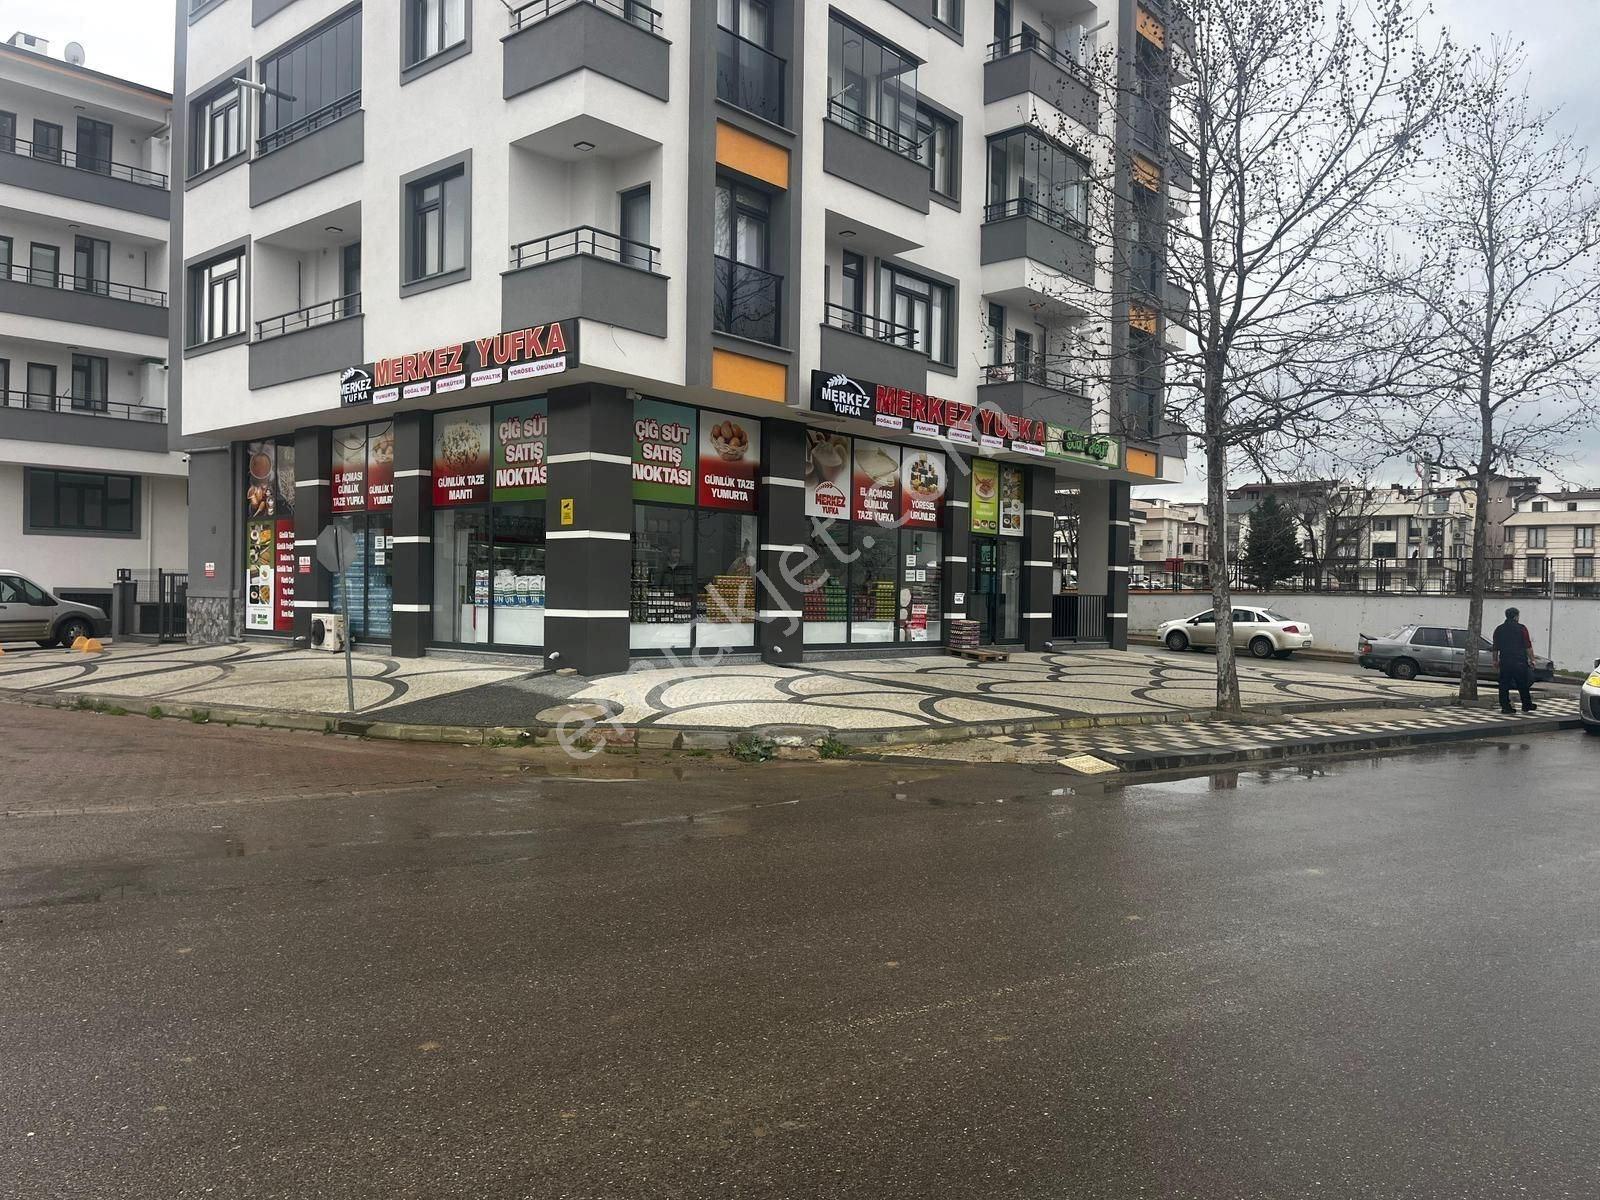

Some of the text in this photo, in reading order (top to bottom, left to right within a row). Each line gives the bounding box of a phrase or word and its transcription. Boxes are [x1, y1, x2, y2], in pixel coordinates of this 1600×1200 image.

[374, 322, 566, 388] MERKEZ YUFKA
[340, 379, 371, 395] MERKEZ
[344, 390, 368, 403] YUFKA
[822, 387, 871, 408] MERKEZ
[834, 402, 861, 416] YUFKA
[876, 385, 972, 432] MERKEZ
[980, 408, 1045, 445] YUFKA
[635, 420, 690, 444] ÇİĞ SÜT
[505, 441, 544, 465] SATIŞ
[643, 443, 682, 467] SATIŞ
[438, 474, 485, 488] GÜNLÜK TAZE
[496, 465, 547, 487] NOKTAS
[632, 463, 692, 486] NOKTASI
[704, 474, 755, 490] GÜNLÜK TAZE
[333, 497, 346, 507] TAZE
[373, 495, 393, 505] YUMUR
[448, 489, 473, 500] MANTI
[711, 488, 748, 501] YUMURTA
[815, 493, 846, 508] MERKEZ
[821, 506, 839, 515] YUFKA
[857, 510, 895, 523] TAZE YUFKA
